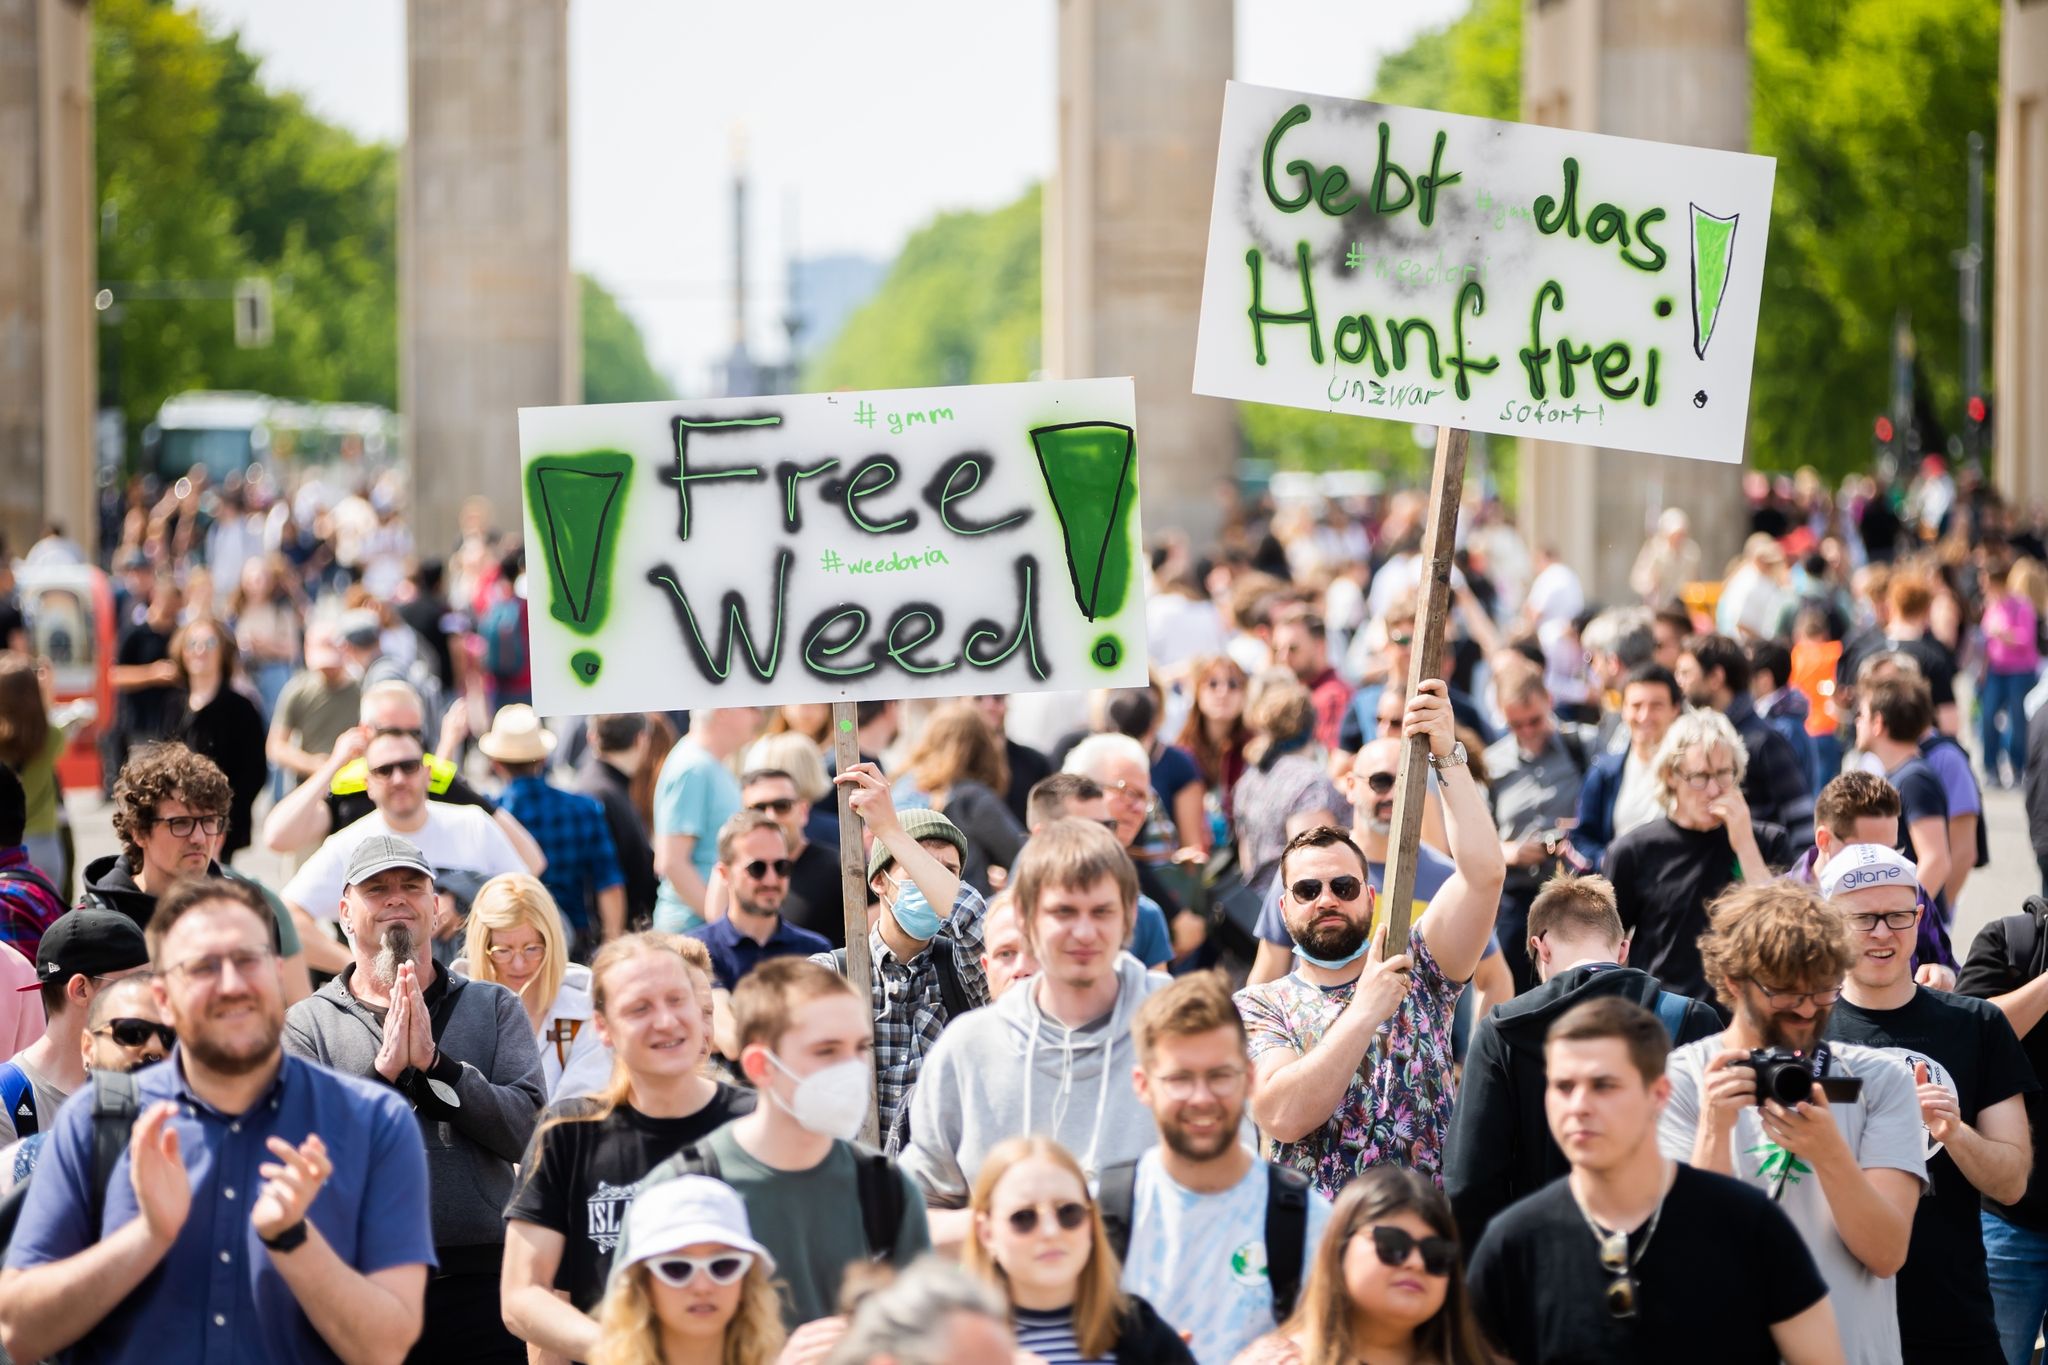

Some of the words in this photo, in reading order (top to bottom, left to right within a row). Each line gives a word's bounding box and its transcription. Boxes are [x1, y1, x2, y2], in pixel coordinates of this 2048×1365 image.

[1262, 104, 1462, 227] Gebt
[1533, 157, 1667, 272] das
[1245, 242, 1499, 401] Hanf
[657, 412, 1034, 543] Free
[647, 546, 1054, 685] Weed
[1842, 867, 1901, 889] gitane
[587, 1201, 631, 1234] ISL
